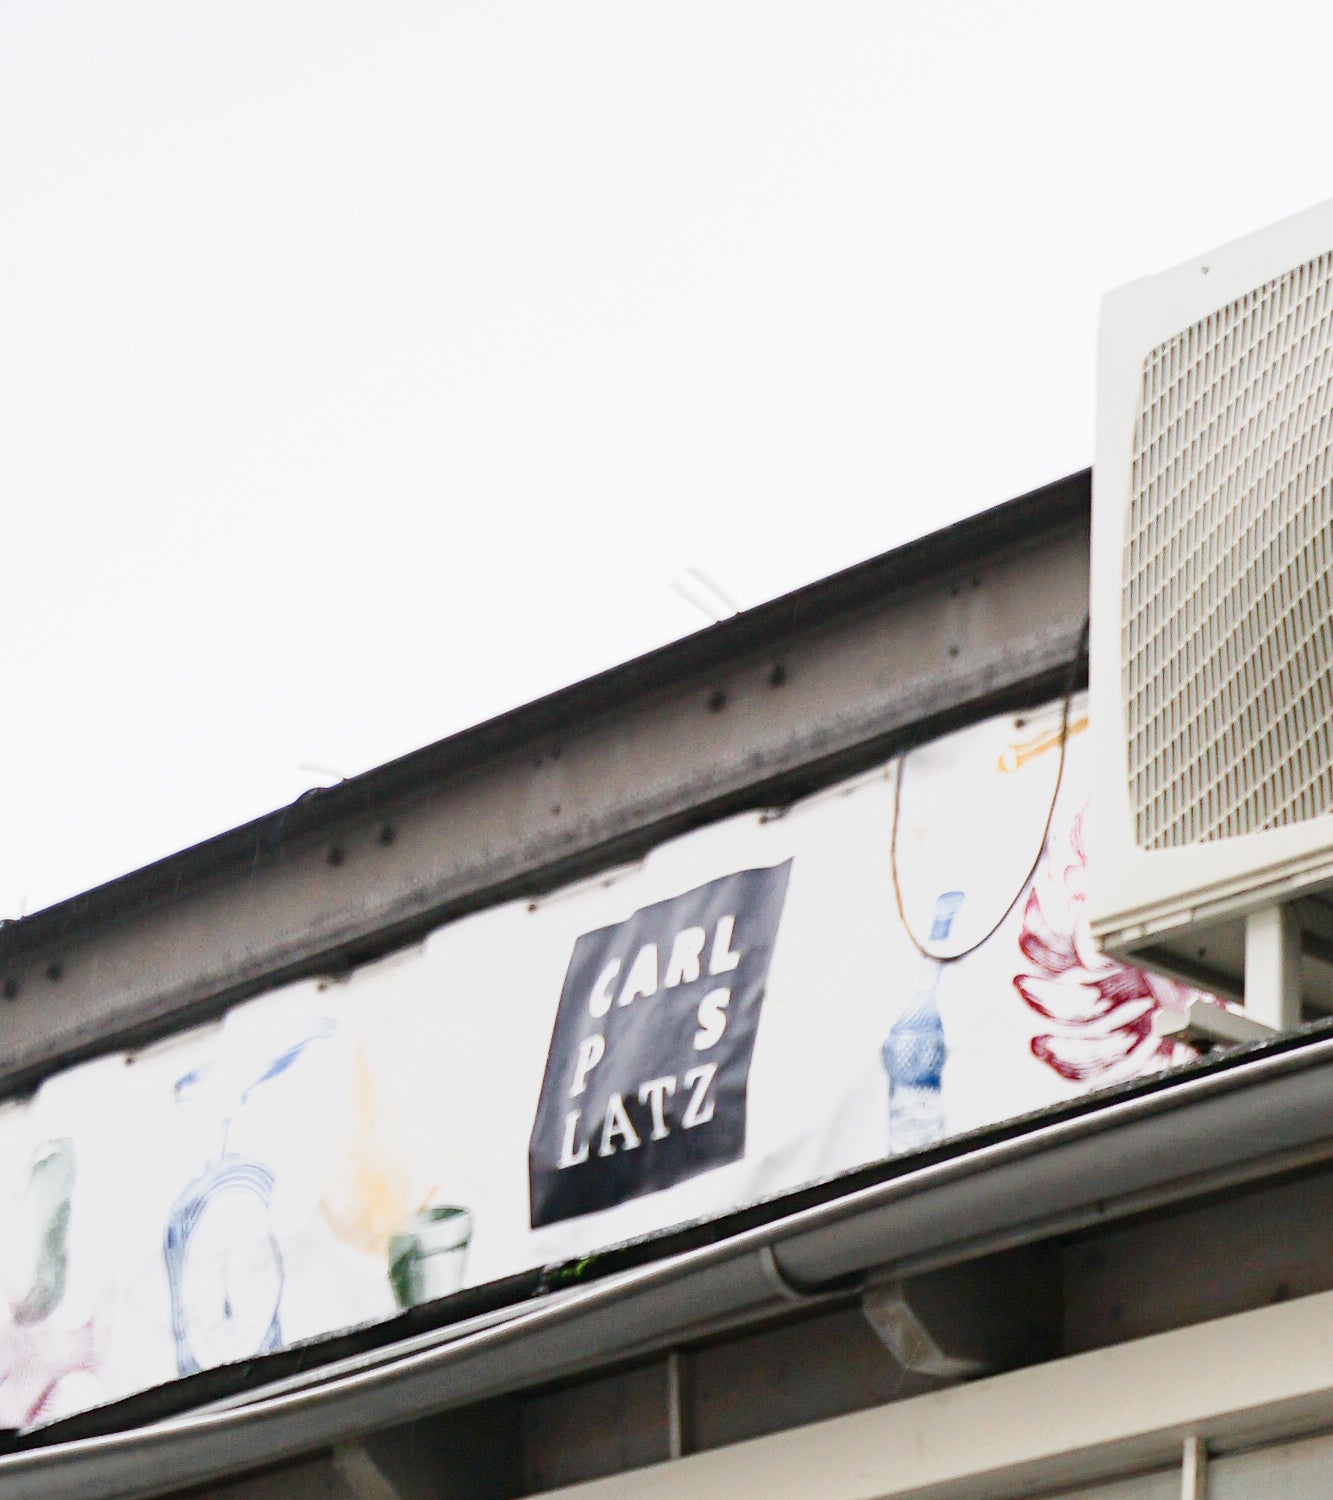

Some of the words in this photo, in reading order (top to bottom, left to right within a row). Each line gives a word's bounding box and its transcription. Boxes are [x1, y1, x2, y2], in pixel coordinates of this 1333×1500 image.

[589, 914, 742, 1018] CARL
[569, 1033, 606, 1099] P
[693, 986, 732, 1051] S
[556, 1066, 718, 1170] LATZ
